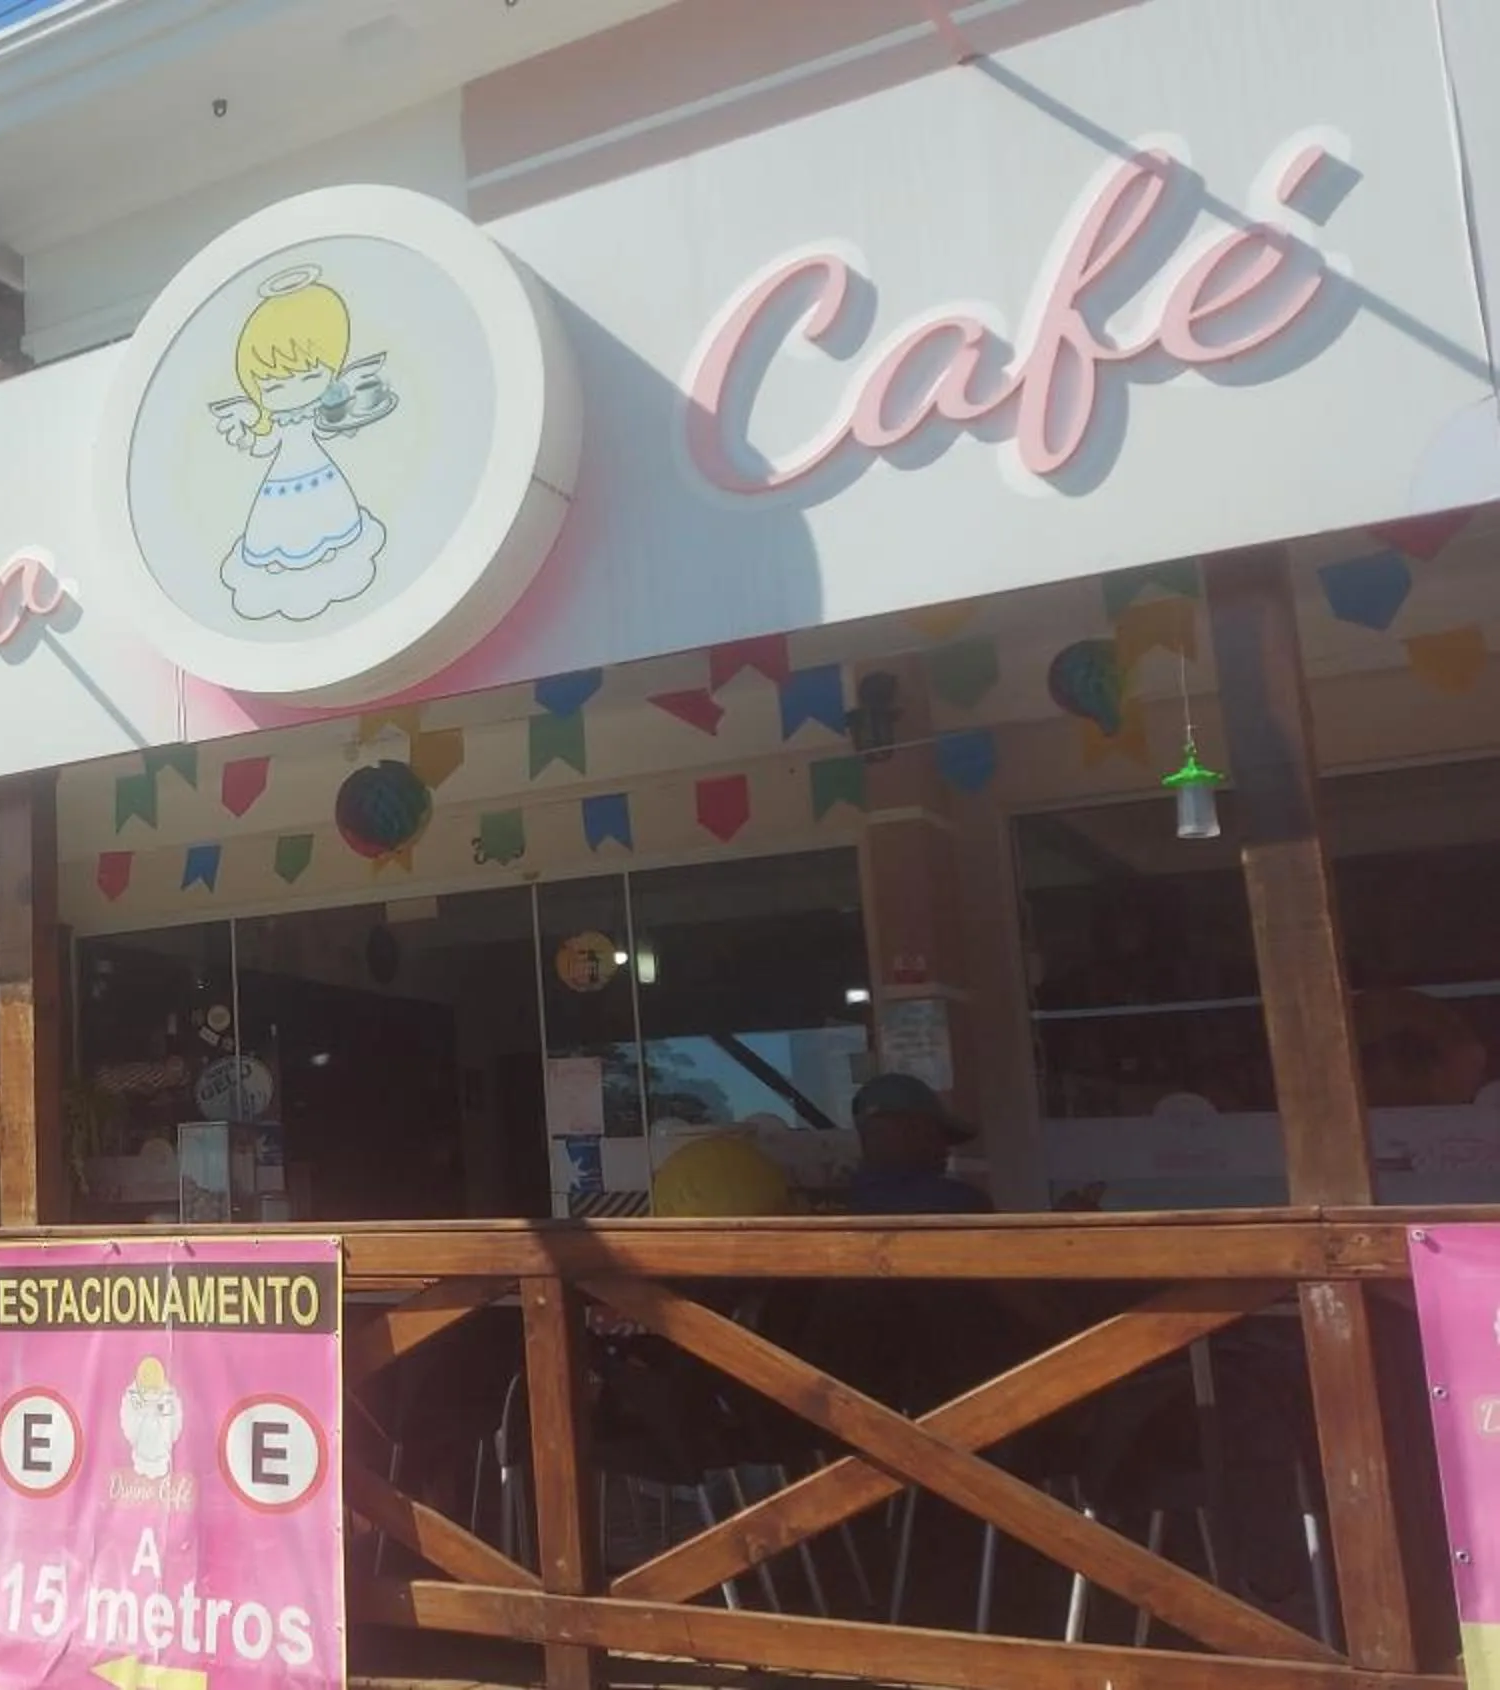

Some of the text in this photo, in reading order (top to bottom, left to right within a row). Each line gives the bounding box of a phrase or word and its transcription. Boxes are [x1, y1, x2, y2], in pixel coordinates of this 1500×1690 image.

[683, 144, 1329, 495] Café
[22, 1413, 53, 1473] E
[251, 1421, 290, 1487] E
[131, 1527, 162, 1579] A
[1, 1561, 314, 1665] 15 metros
